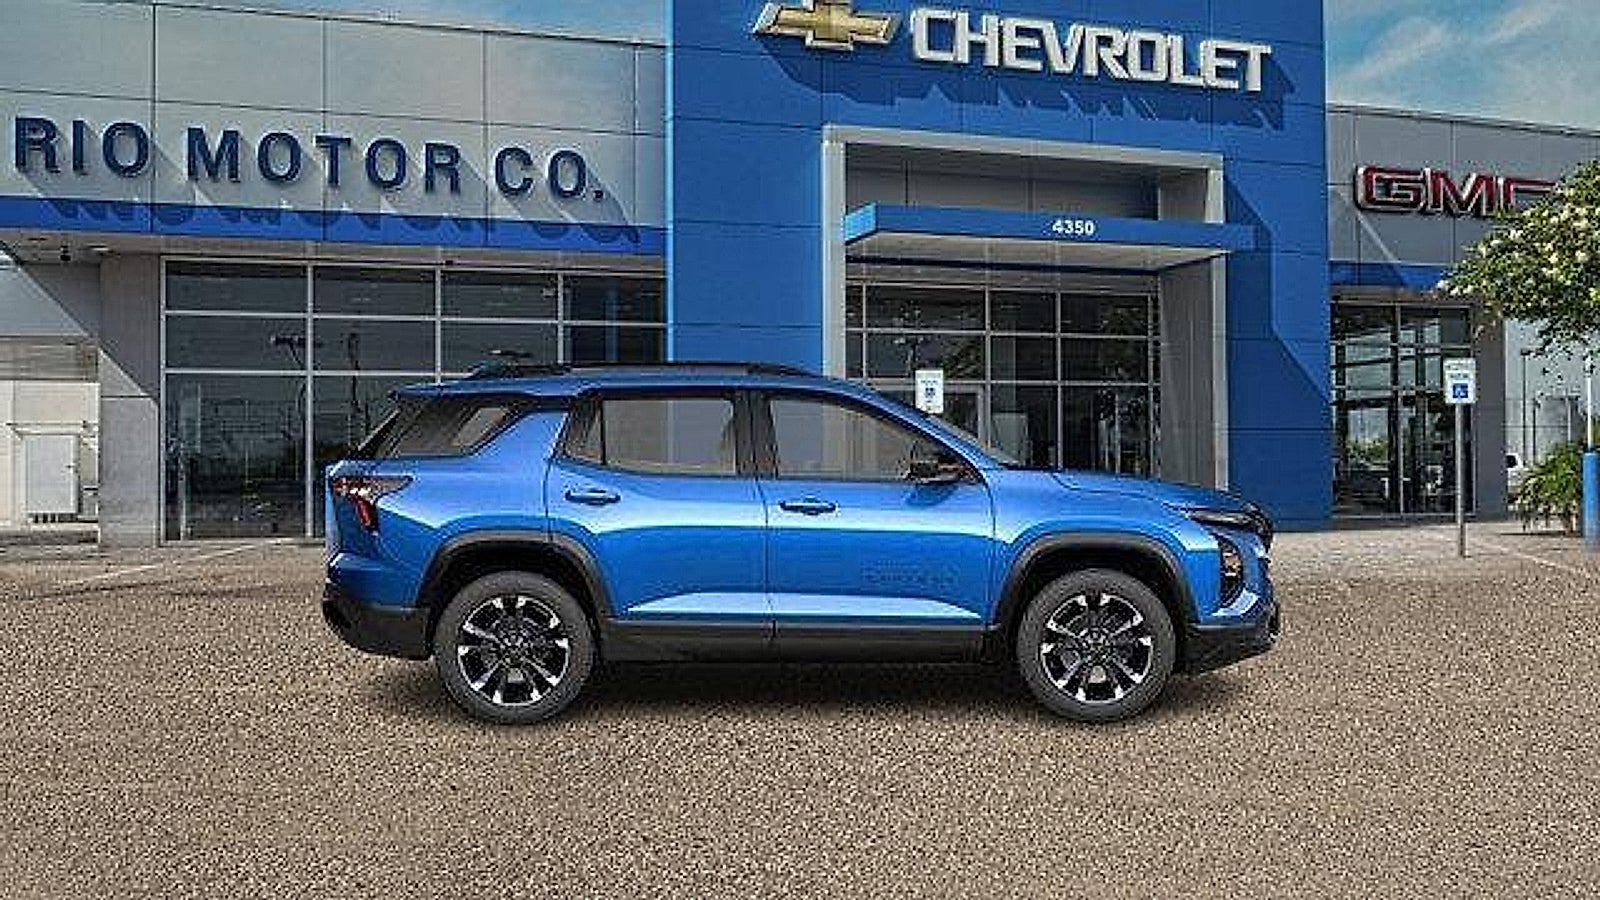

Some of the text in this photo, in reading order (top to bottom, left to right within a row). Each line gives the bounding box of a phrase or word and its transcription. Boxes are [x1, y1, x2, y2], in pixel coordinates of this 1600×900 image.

[911, 7, 1272, 92] CHEVROLET
[15, 117, 605, 201] RIO MOTOR CO.
[1052, 219, 1094, 235] 4350
